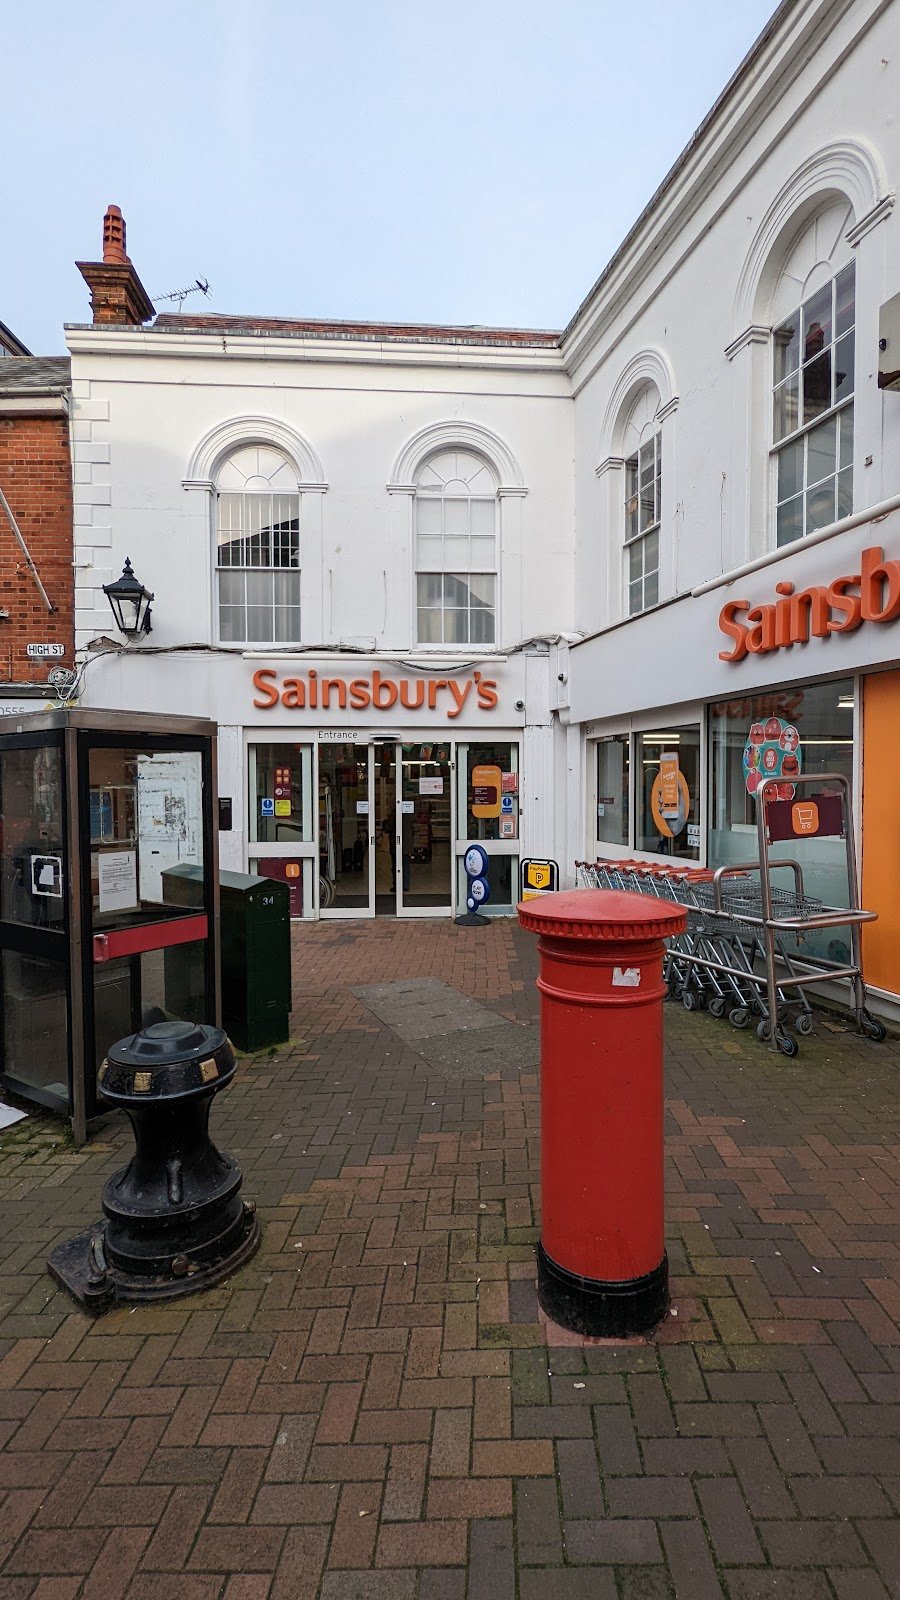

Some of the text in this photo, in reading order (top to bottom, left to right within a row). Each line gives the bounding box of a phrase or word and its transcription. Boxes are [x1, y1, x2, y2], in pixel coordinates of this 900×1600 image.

[718, 546, 900, 662] Sainsb
[28, 645, 49, 654] HIGH
[252, 669, 498, 718] Sainsbury's
[318, 730, 358, 739] Entrance
[262, 895, 274, 906] 34
